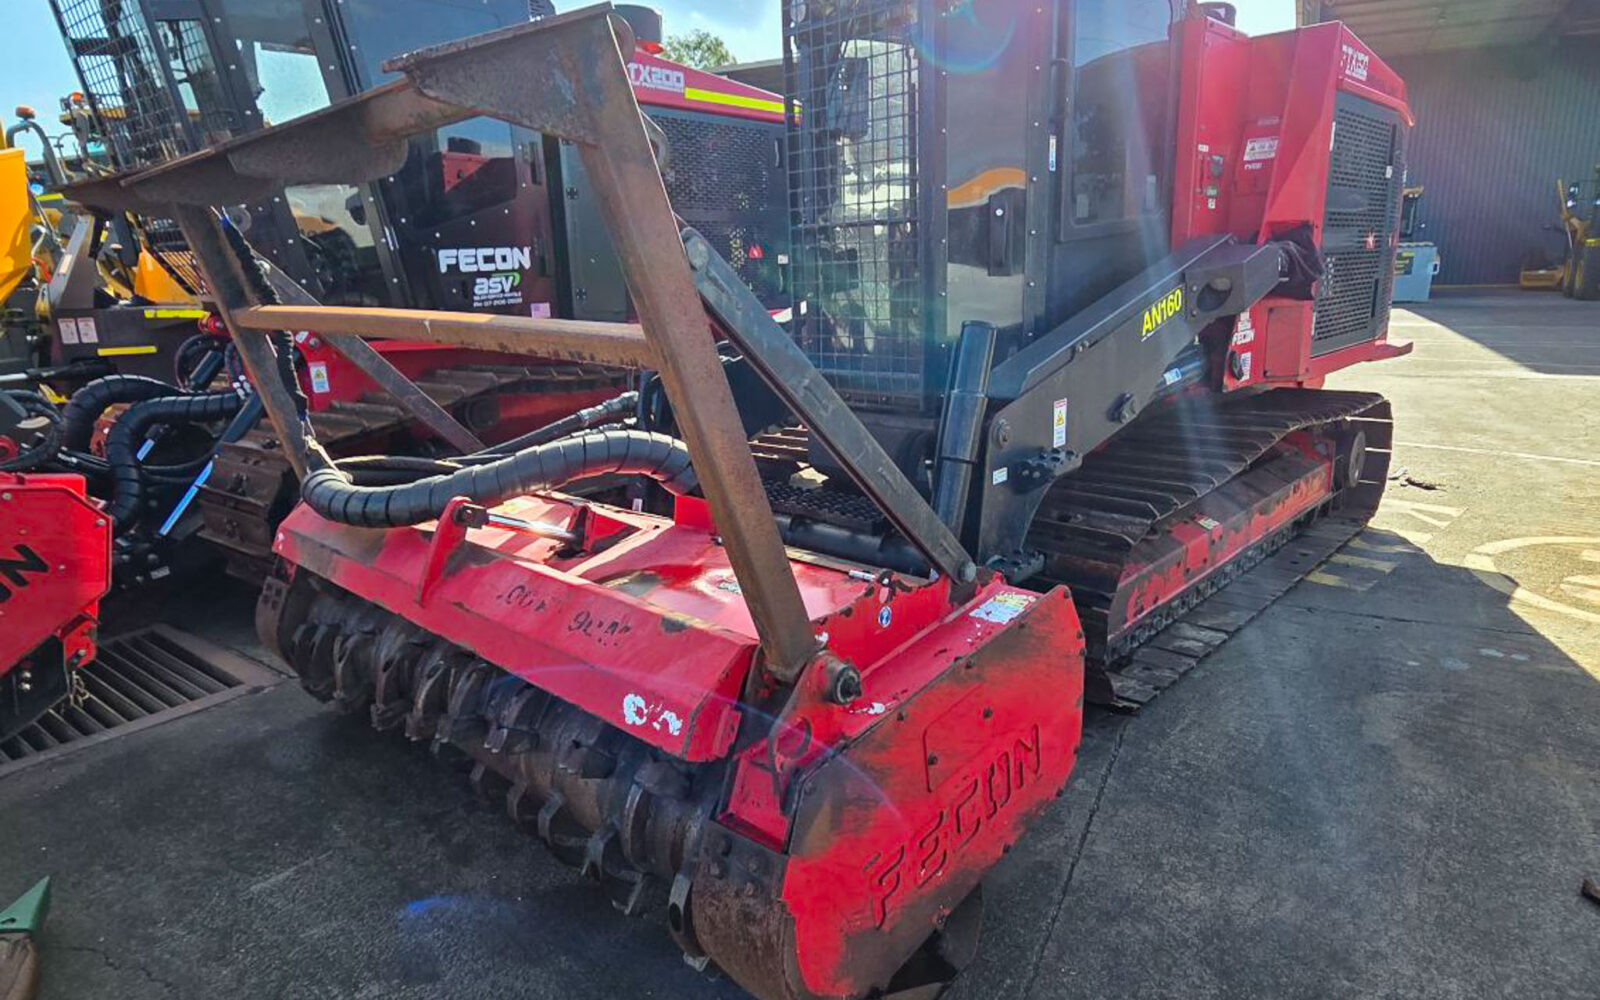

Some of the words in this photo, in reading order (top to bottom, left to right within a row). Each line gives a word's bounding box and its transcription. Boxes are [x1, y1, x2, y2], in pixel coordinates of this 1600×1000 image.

[438, 246, 532, 273] FECON
[1142, 289, 1182, 336] AN160
[863, 723, 1041, 931] FECON
